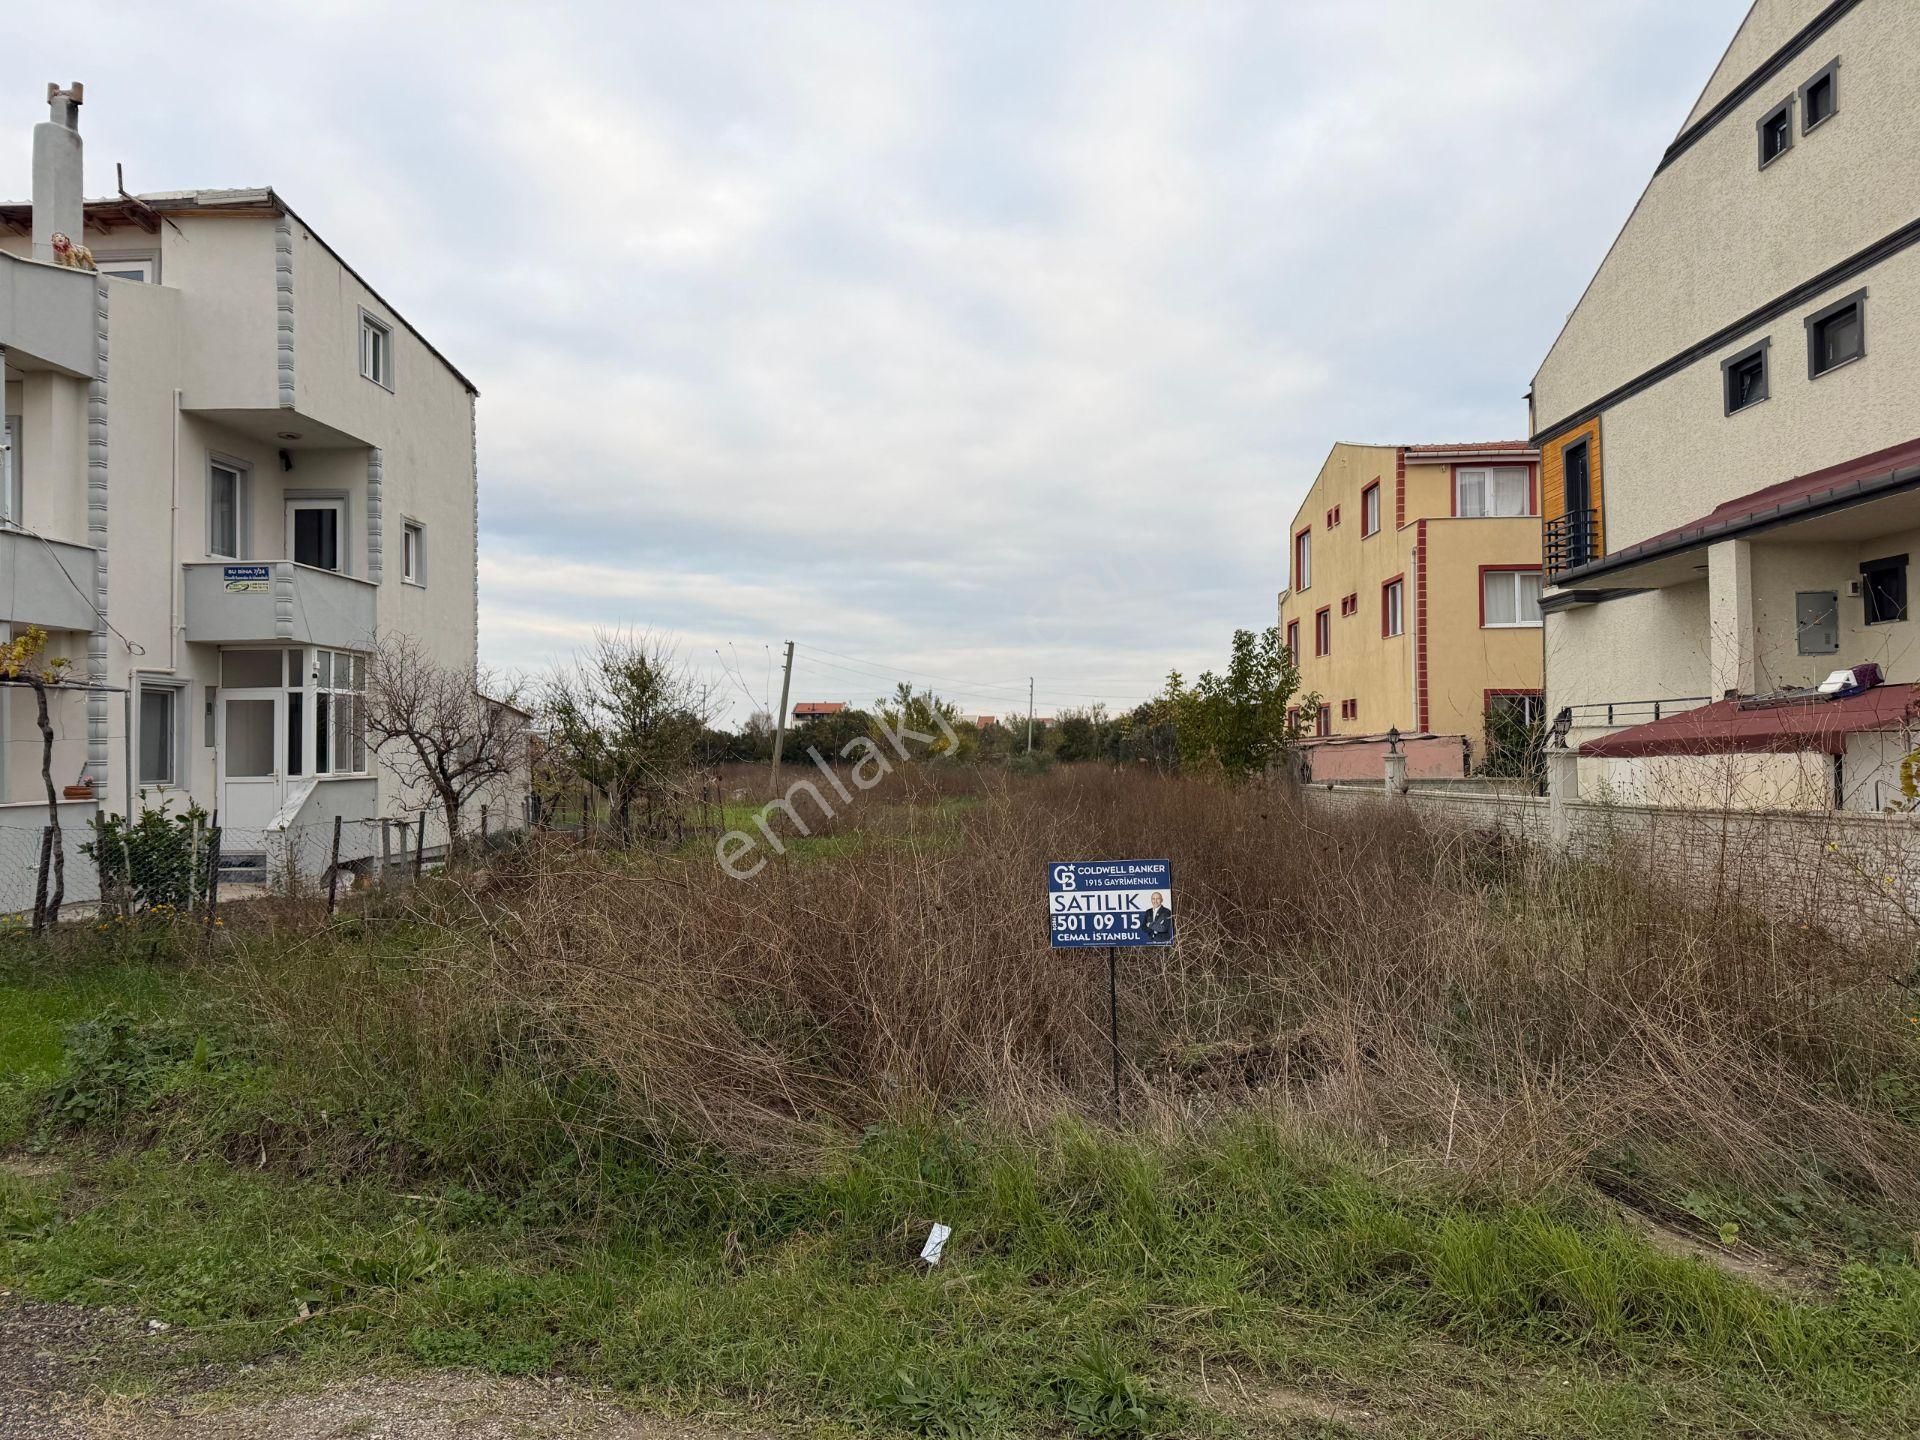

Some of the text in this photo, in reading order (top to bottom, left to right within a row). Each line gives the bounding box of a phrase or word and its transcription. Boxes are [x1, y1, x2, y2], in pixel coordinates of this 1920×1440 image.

[1077, 864, 1165, 875] COLDWELL BANKER
[1085, 877, 1159, 887] 1915 GAYRİMENKUL
[1054, 893, 1140, 912] SATILIK
[1057, 915, 1086, 931] 501
[1093, 914, 1115, 930] 09
[1121, 913, 1141, 929] 15
[1057, 931, 1141, 941] CEMAL İSTANBUL
